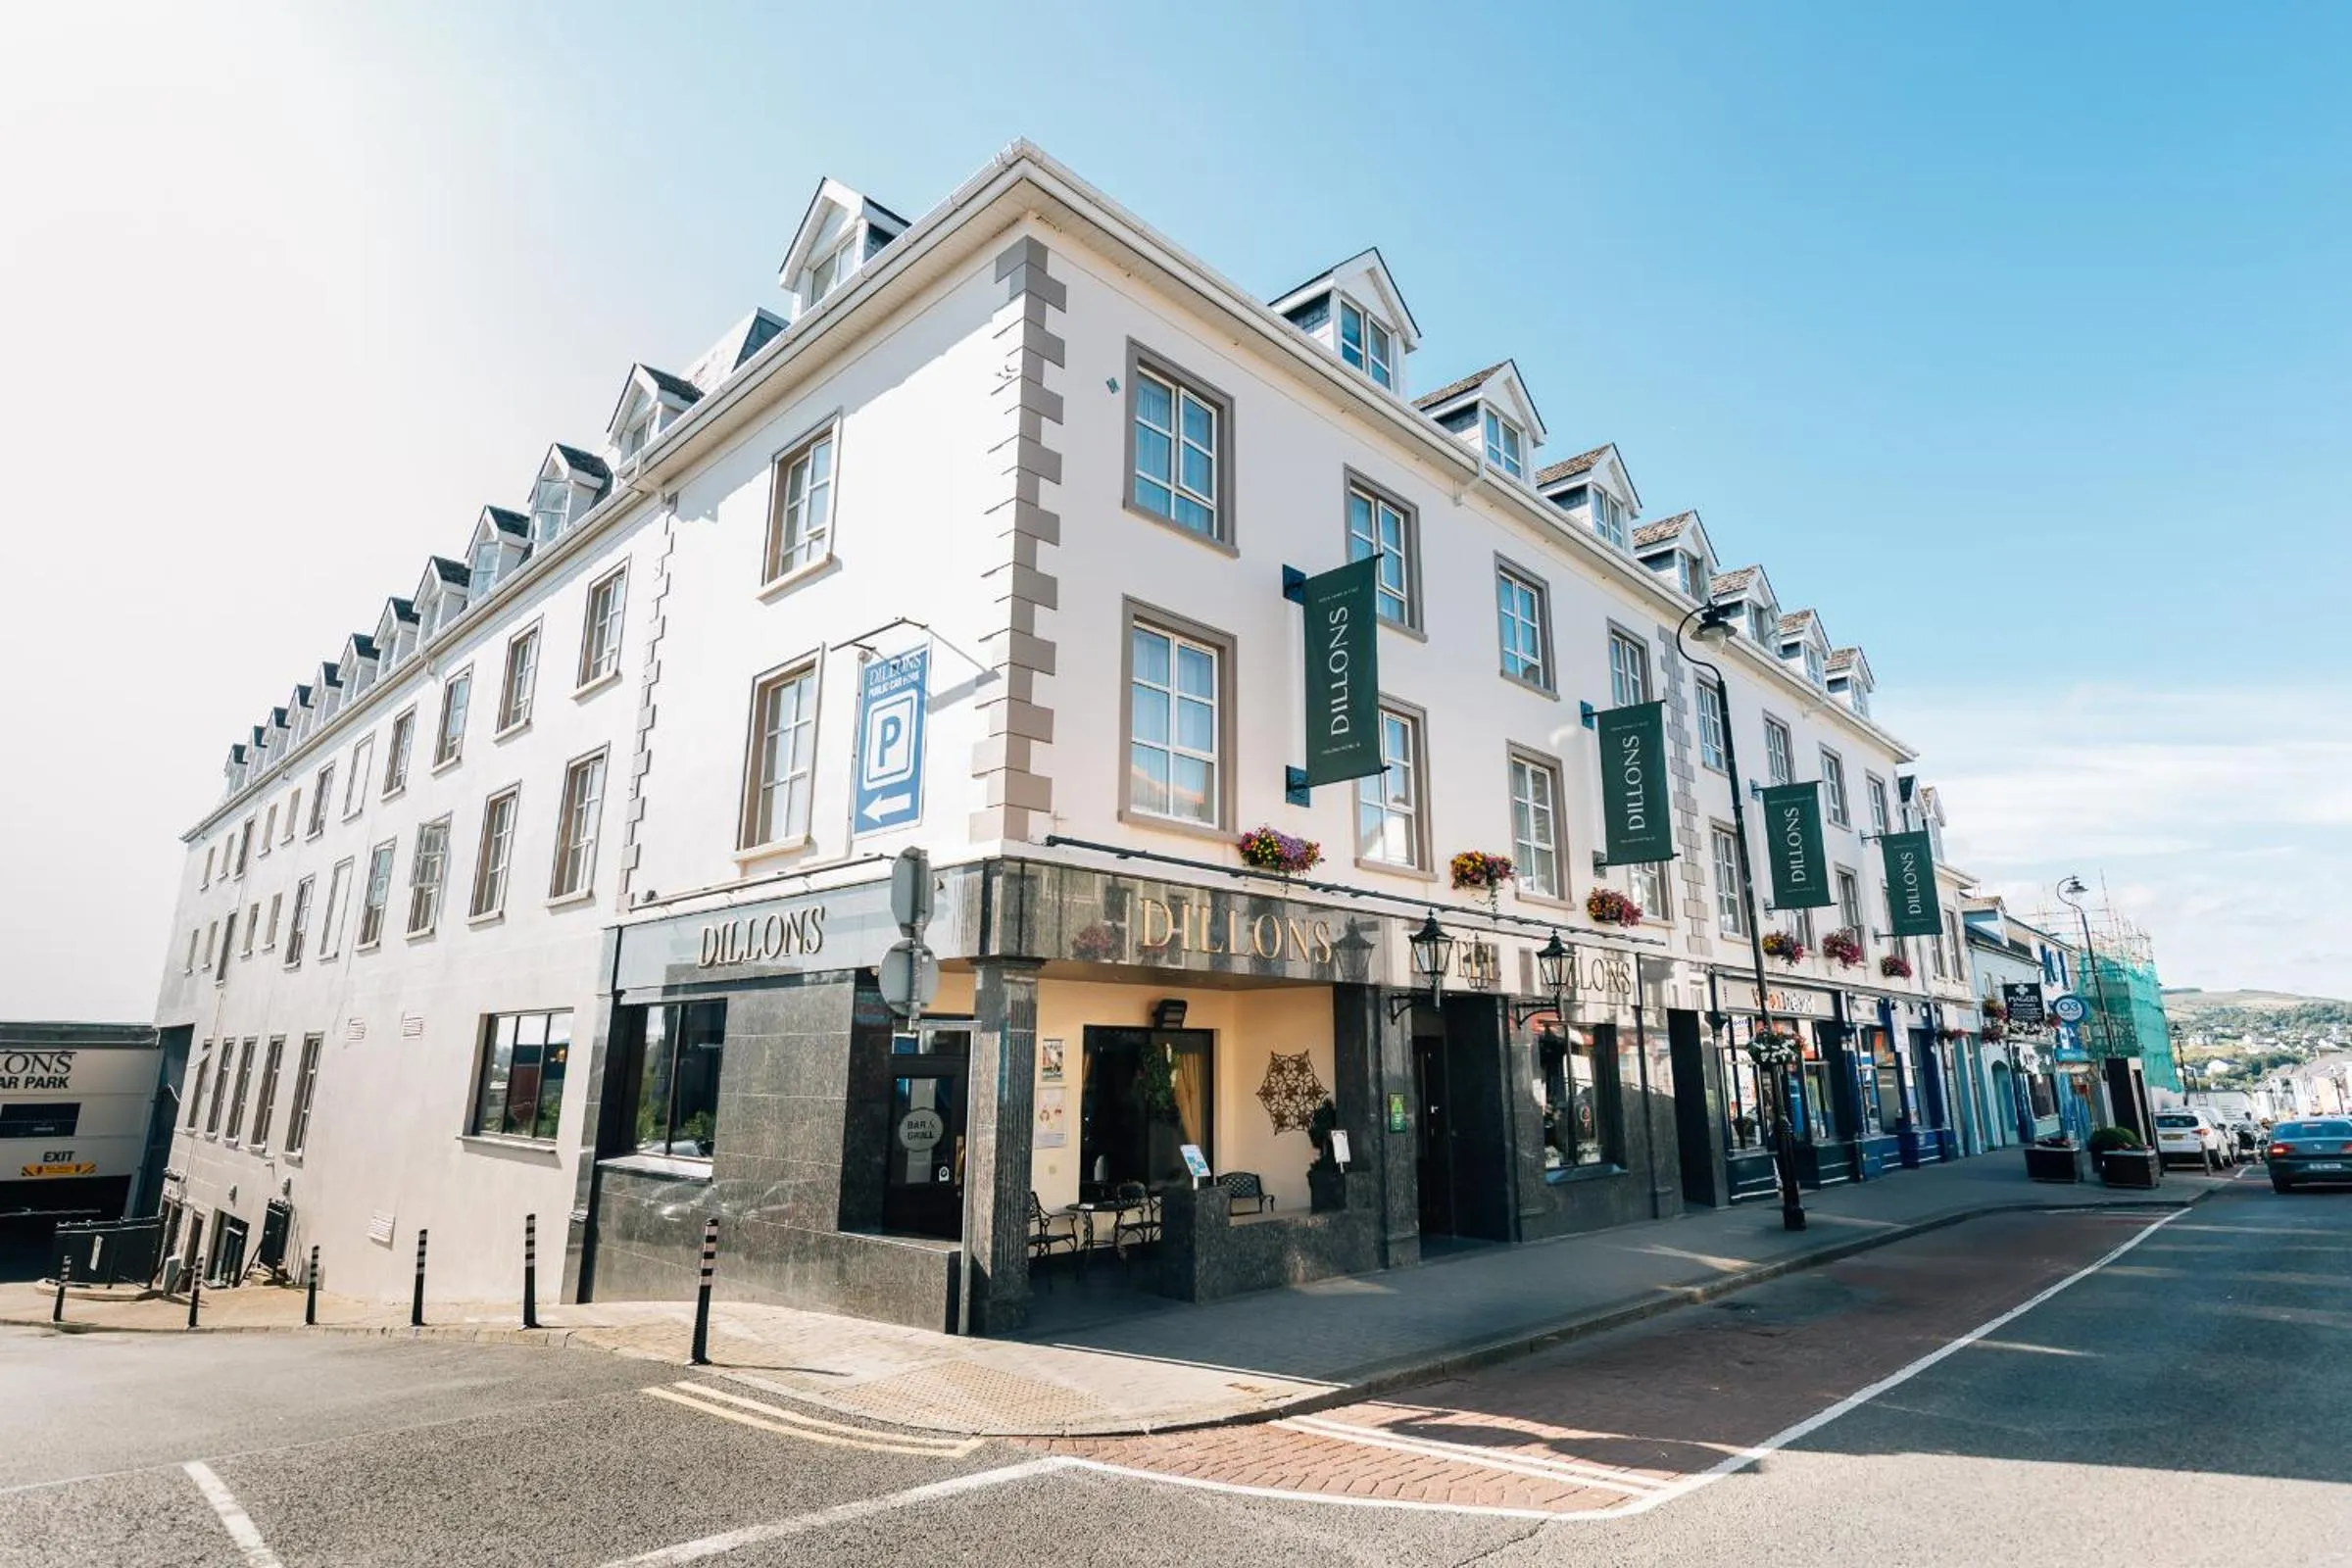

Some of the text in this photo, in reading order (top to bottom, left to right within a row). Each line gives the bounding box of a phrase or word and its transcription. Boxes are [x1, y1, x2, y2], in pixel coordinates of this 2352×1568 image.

[1329, 606, 1349, 736] DILLONS
[878, 714, 903, 767] P
[1623, 735, 1645, 831] DILLONS
[1785, 807, 1806, 883] DILLONS
[1900, 852, 1922, 915] DILLONS
[698, 906, 826, 968] DILLONS
[1140, 898, 1333, 964] DILLONS
[0, 1053, 74, 1074] ONS
[24, 1075, 70, 1089] PARK
[43, 1151, 75, 1162] EXIT
